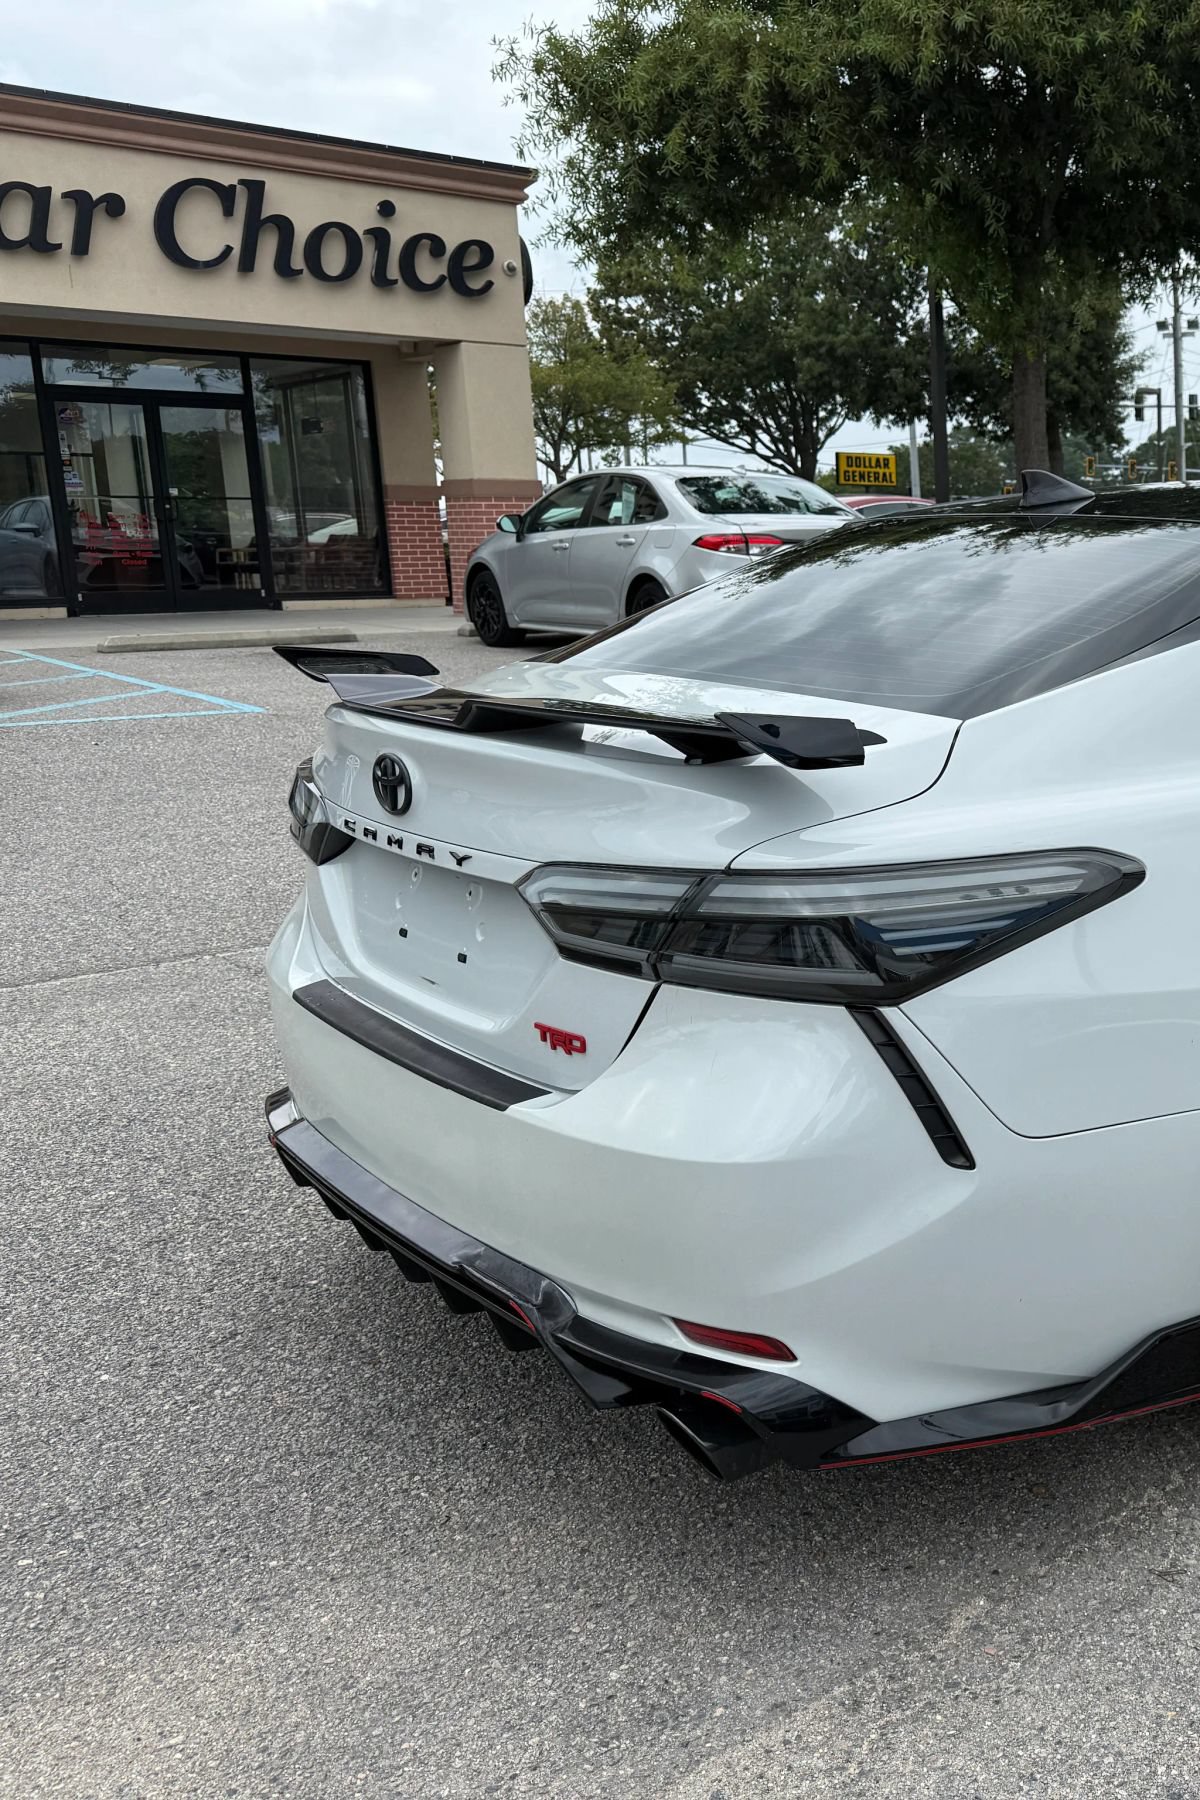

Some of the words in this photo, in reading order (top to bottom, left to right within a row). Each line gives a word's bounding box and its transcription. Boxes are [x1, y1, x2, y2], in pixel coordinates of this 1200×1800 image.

[154, 177, 495, 297] Choice
[843, 469, 895, 484] GENERAL
[846, 455, 891, 469] DOLLAR
[343, 817, 473, 867] CAMRY
[533, 1021, 587, 1056] TRD
